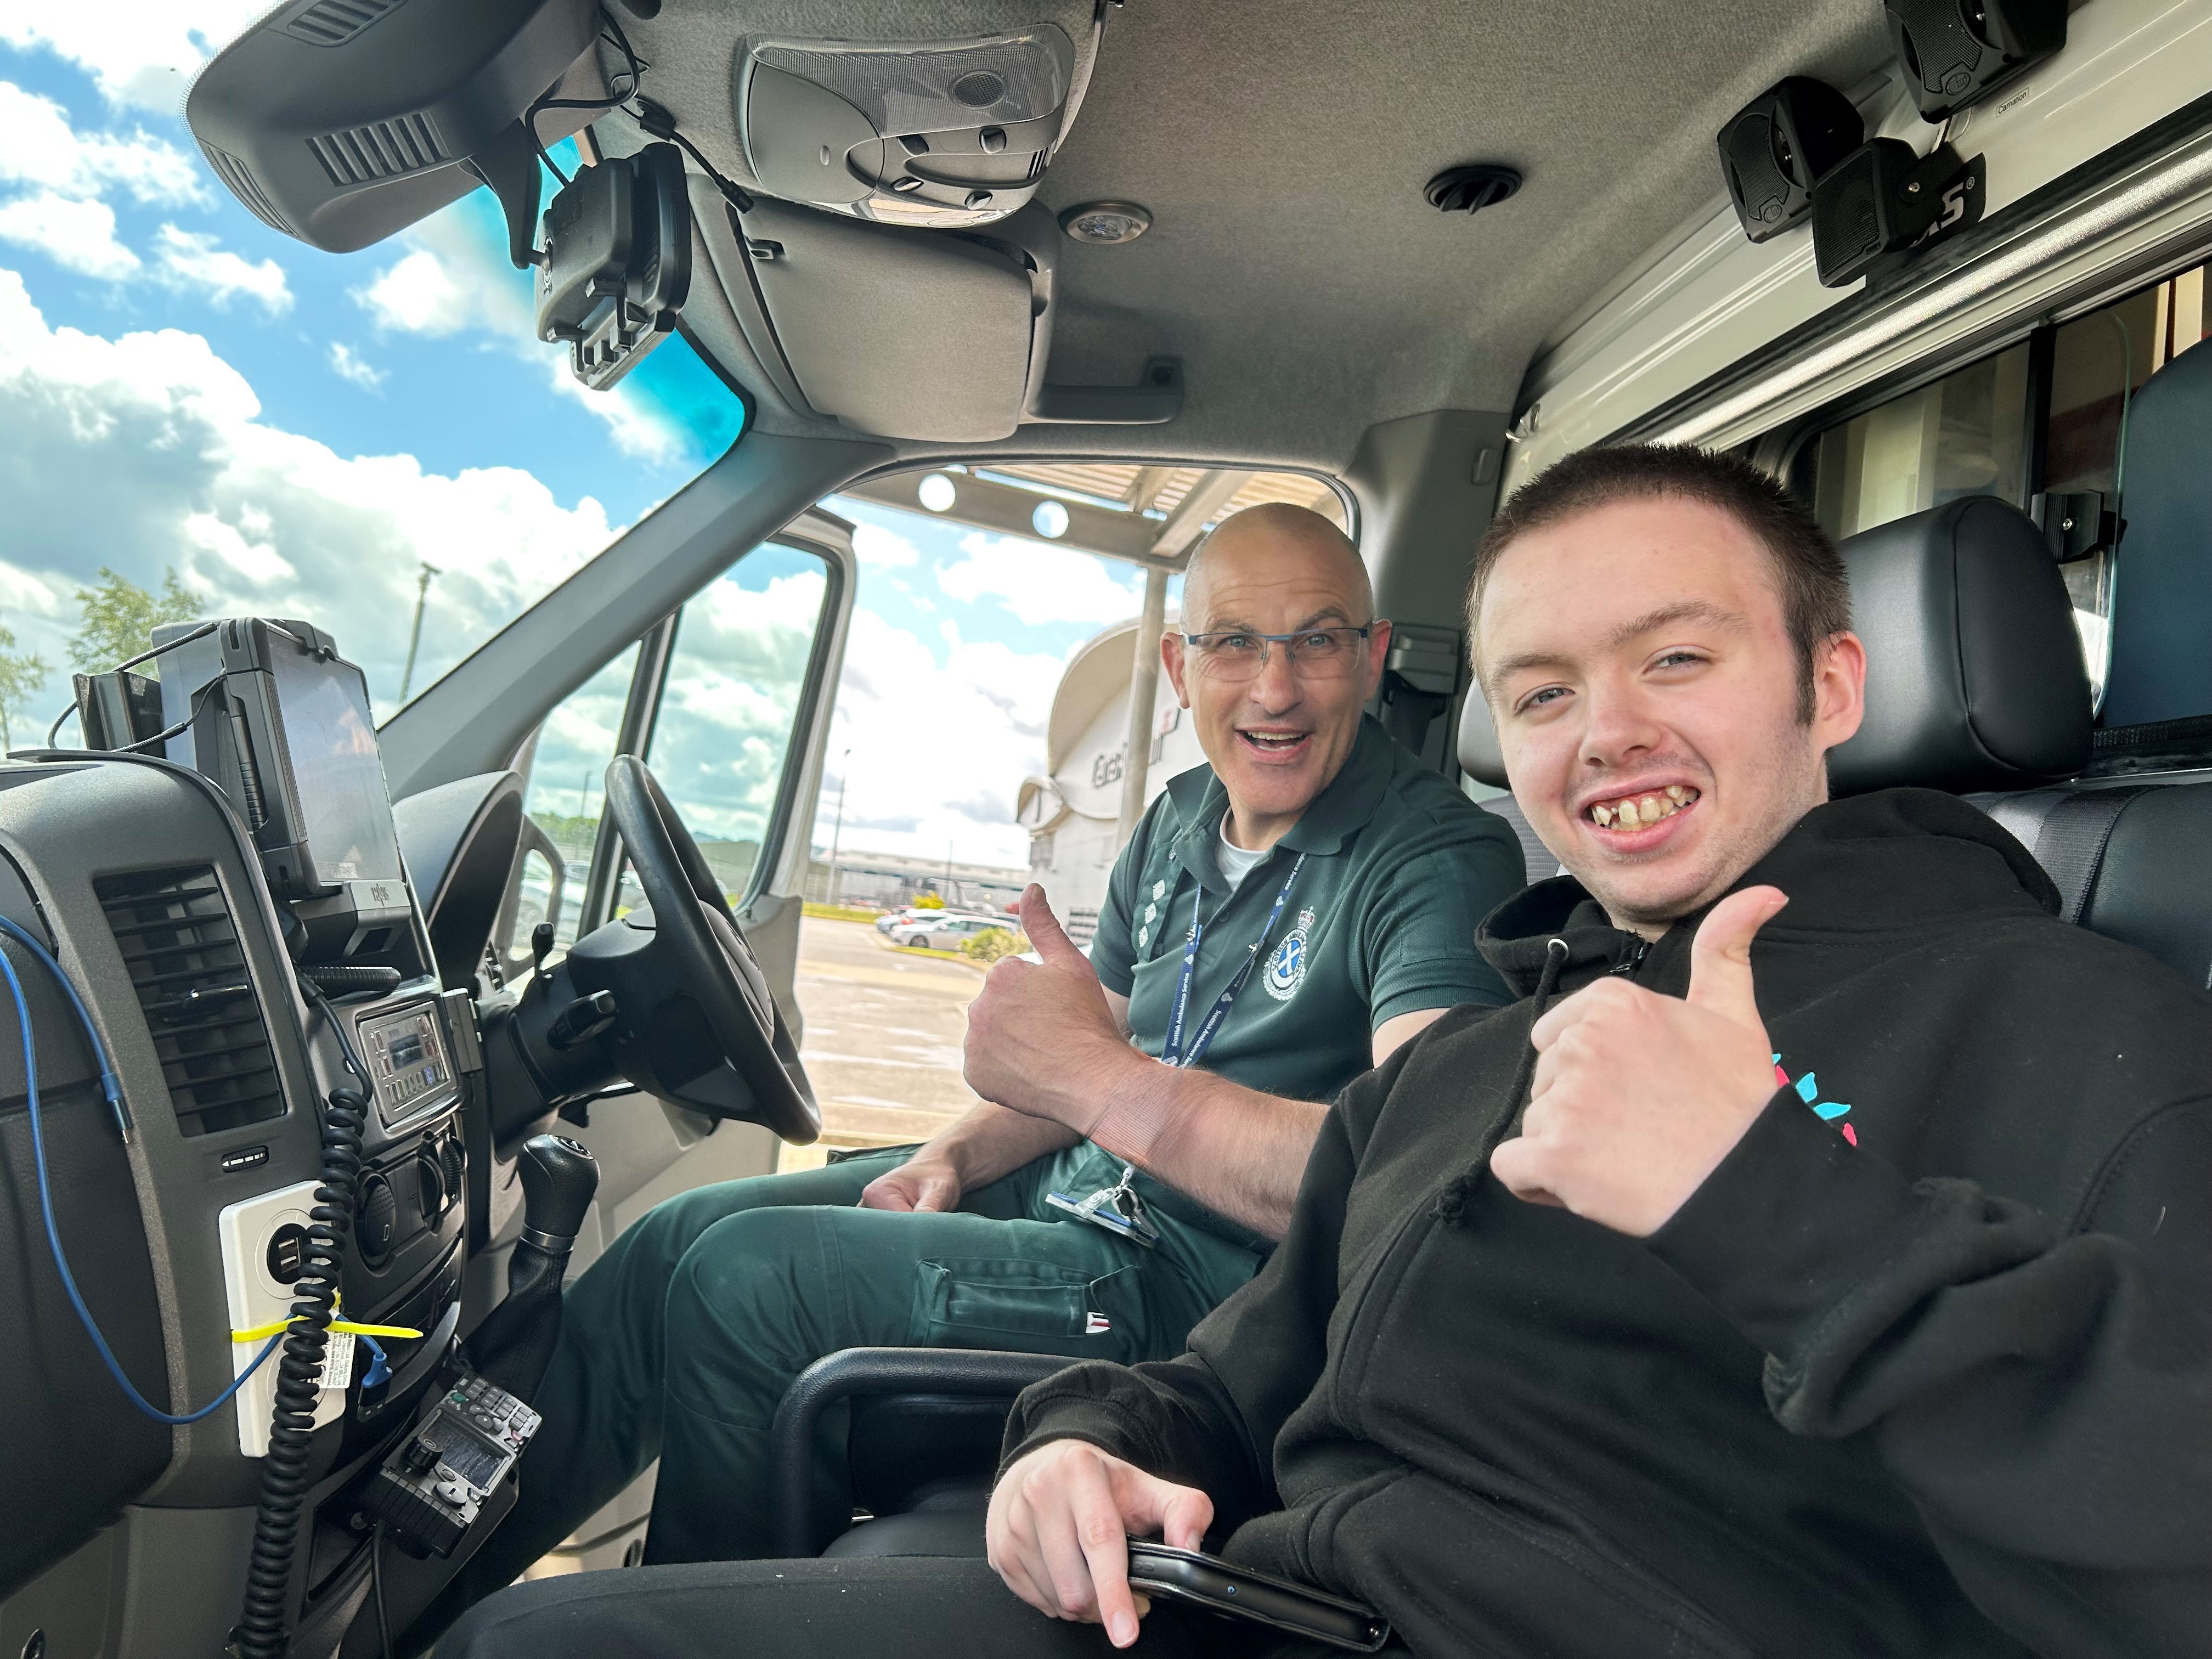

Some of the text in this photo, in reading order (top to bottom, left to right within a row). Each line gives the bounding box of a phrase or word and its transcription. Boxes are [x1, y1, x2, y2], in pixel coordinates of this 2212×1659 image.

[1171, 972, 1190, 1047] Scottish Ambulance Service
[1189, 1009, 1222, 1057] Scottish Ambulance
